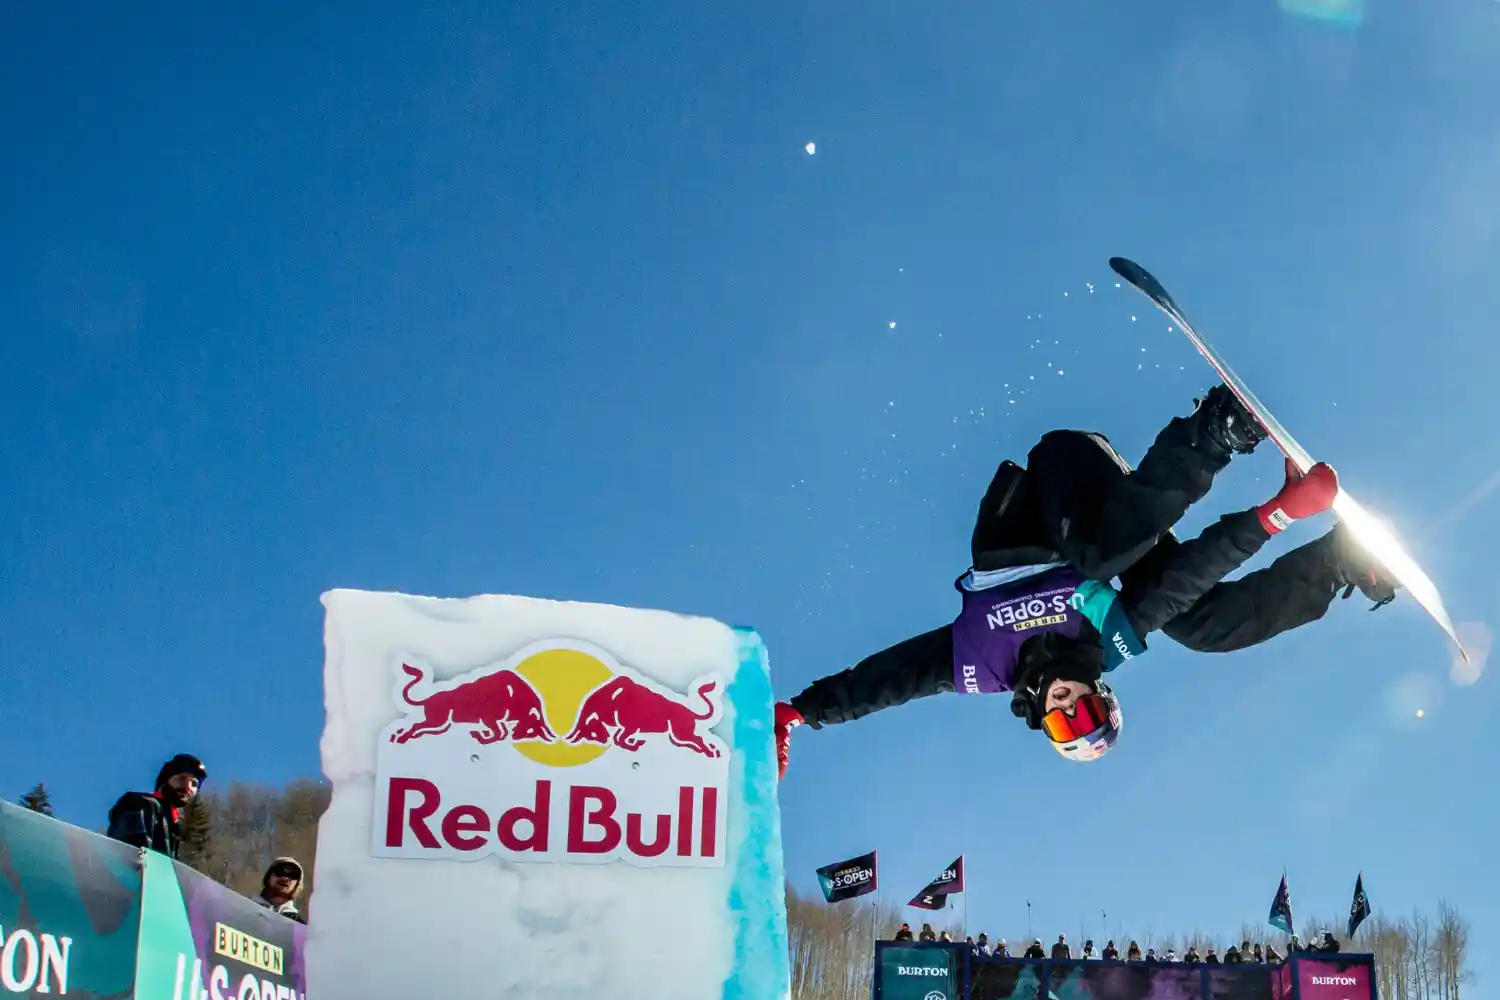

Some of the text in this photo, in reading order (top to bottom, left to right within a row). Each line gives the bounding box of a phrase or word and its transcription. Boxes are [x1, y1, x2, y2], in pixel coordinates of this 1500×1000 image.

[1015, 614, 1065, 631] BURTON
[1112, 632, 1133, 660] YOTA
[385, 777, 717, 857] Red Bull
[0, 926, 72, 995] ON
[218, 926, 281, 971] BURTON
[898, 966, 948, 976] BURTON
[1312, 976, 1356, 985] BURTON
